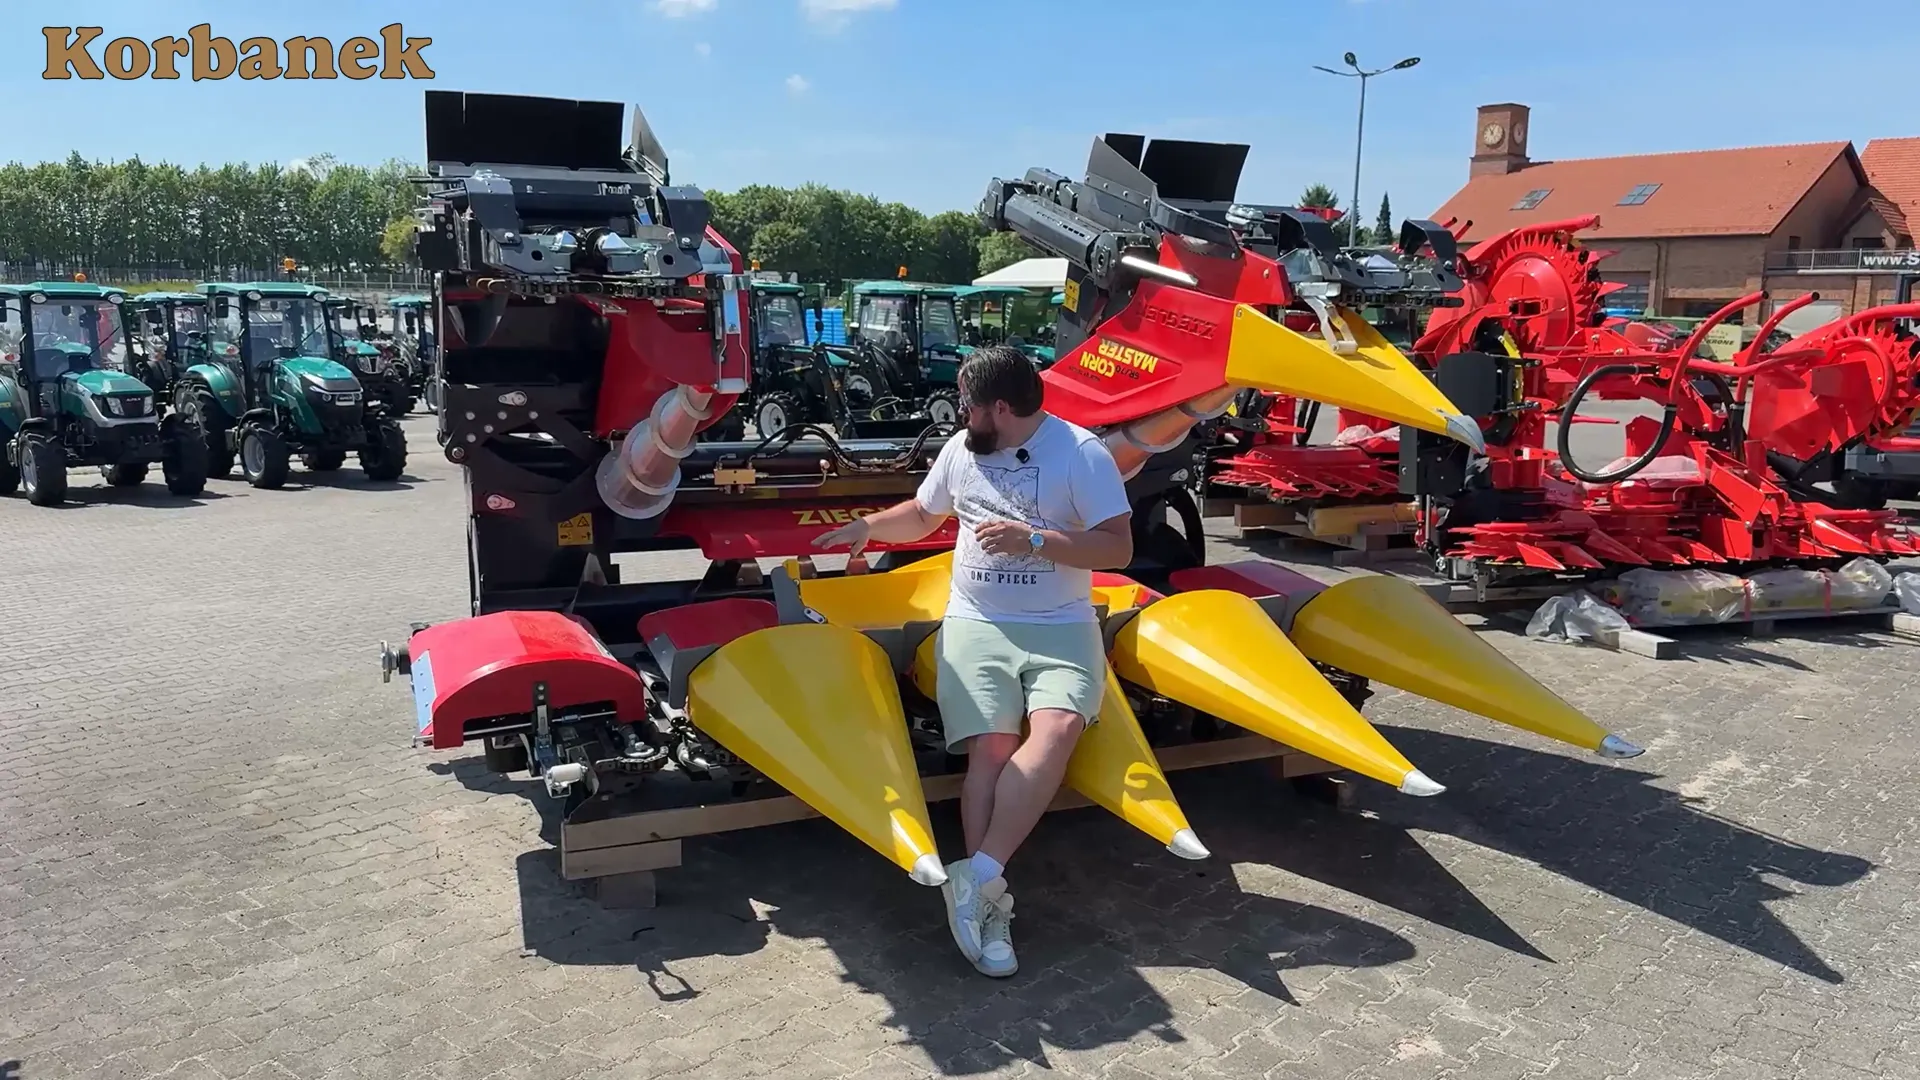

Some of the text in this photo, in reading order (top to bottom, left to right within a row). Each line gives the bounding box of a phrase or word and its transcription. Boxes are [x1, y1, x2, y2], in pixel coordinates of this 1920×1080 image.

[1079, 350, 1116, 378] CORN
[1097, 338, 1159, 374] MASTER
[792, 507, 885, 526] ZIEG
[970, 570, 1037, 585] ONE PIECE
